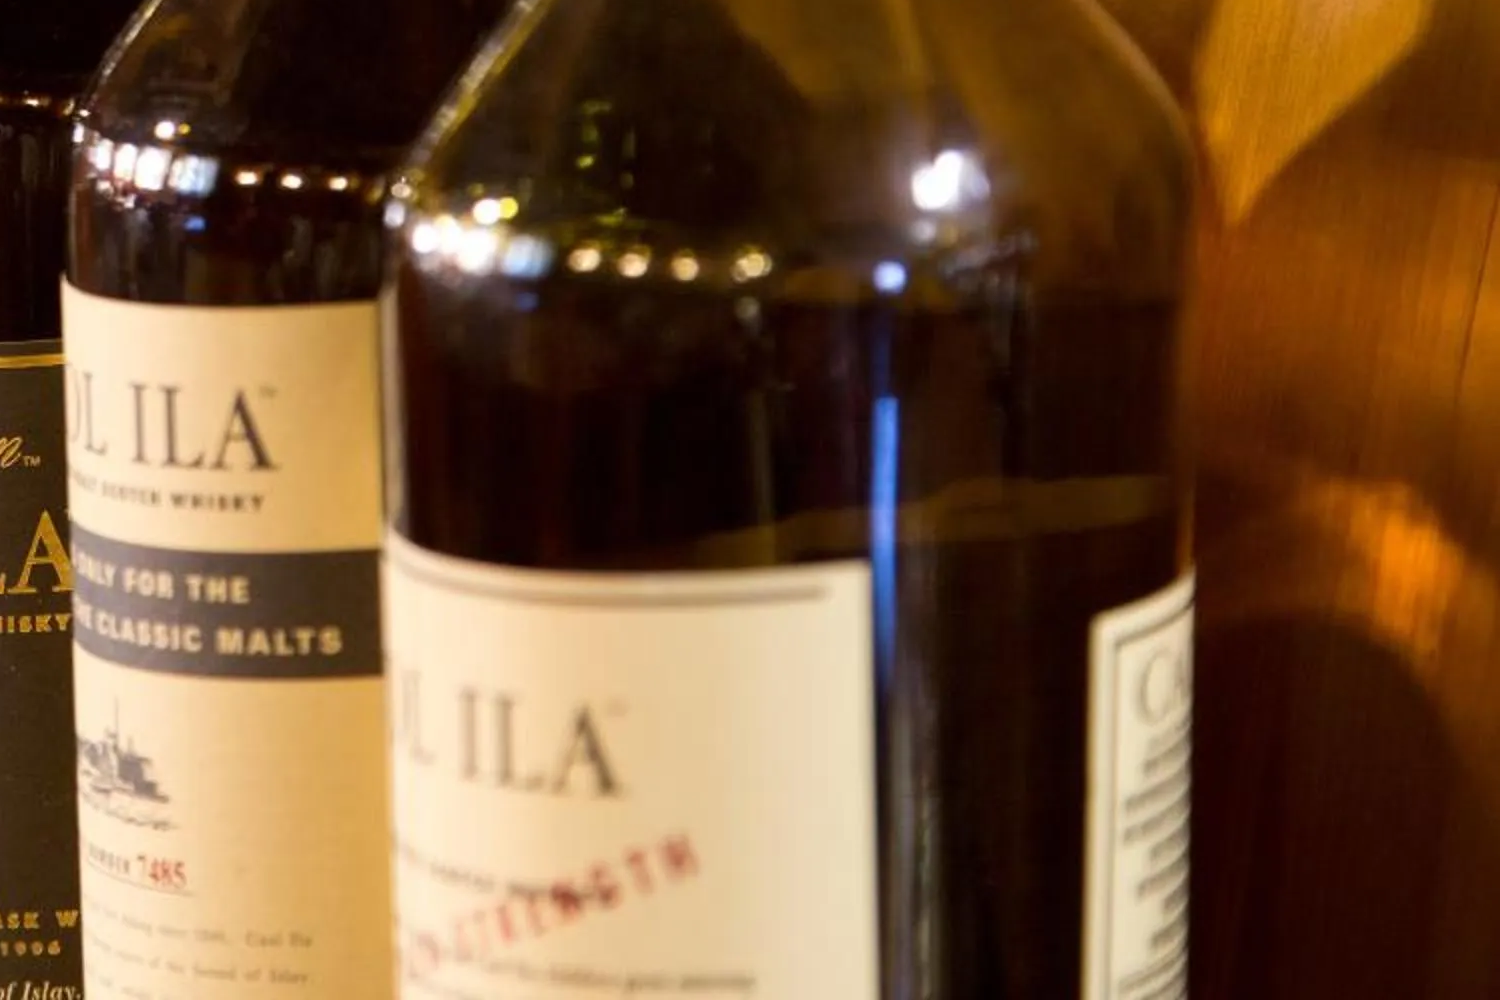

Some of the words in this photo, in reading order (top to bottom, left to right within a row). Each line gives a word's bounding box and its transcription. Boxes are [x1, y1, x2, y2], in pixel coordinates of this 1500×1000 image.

[130, 382, 280, 471] ILA
[123, 566, 173, 600] FOR
[184, 573, 251, 605] THE
[97, 609, 204, 653] CLASSIC
[215, 626, 343, 657] MALTS
[460, 687, 627, 803] ILA
